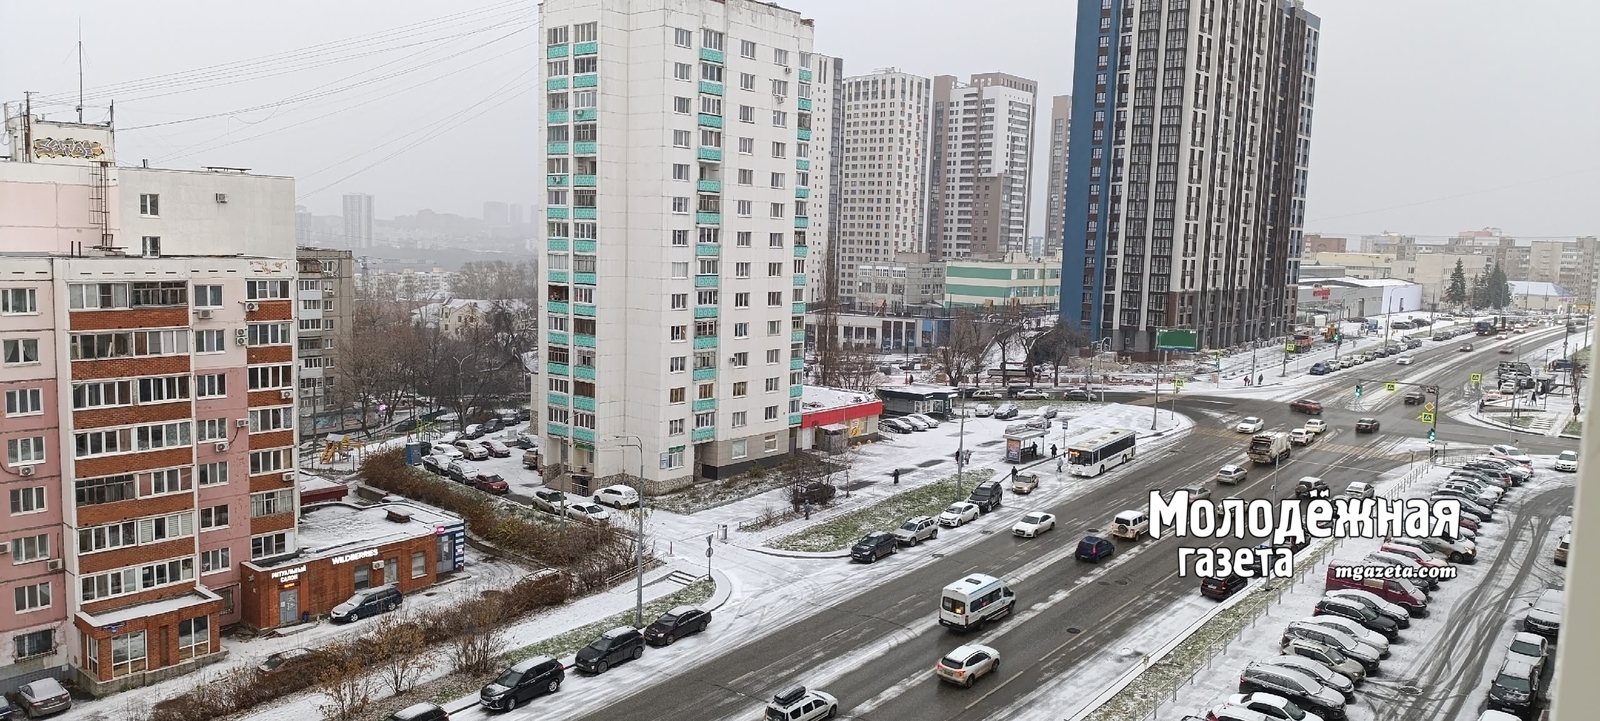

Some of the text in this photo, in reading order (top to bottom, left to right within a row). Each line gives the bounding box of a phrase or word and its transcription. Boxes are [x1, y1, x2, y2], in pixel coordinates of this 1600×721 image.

[332, 549, 379, 565] WILDBERRIES
[271, 565, 307, 579] РИТУАЛЬНЫЙ
[280, 574, 298, 583] САЛОН
